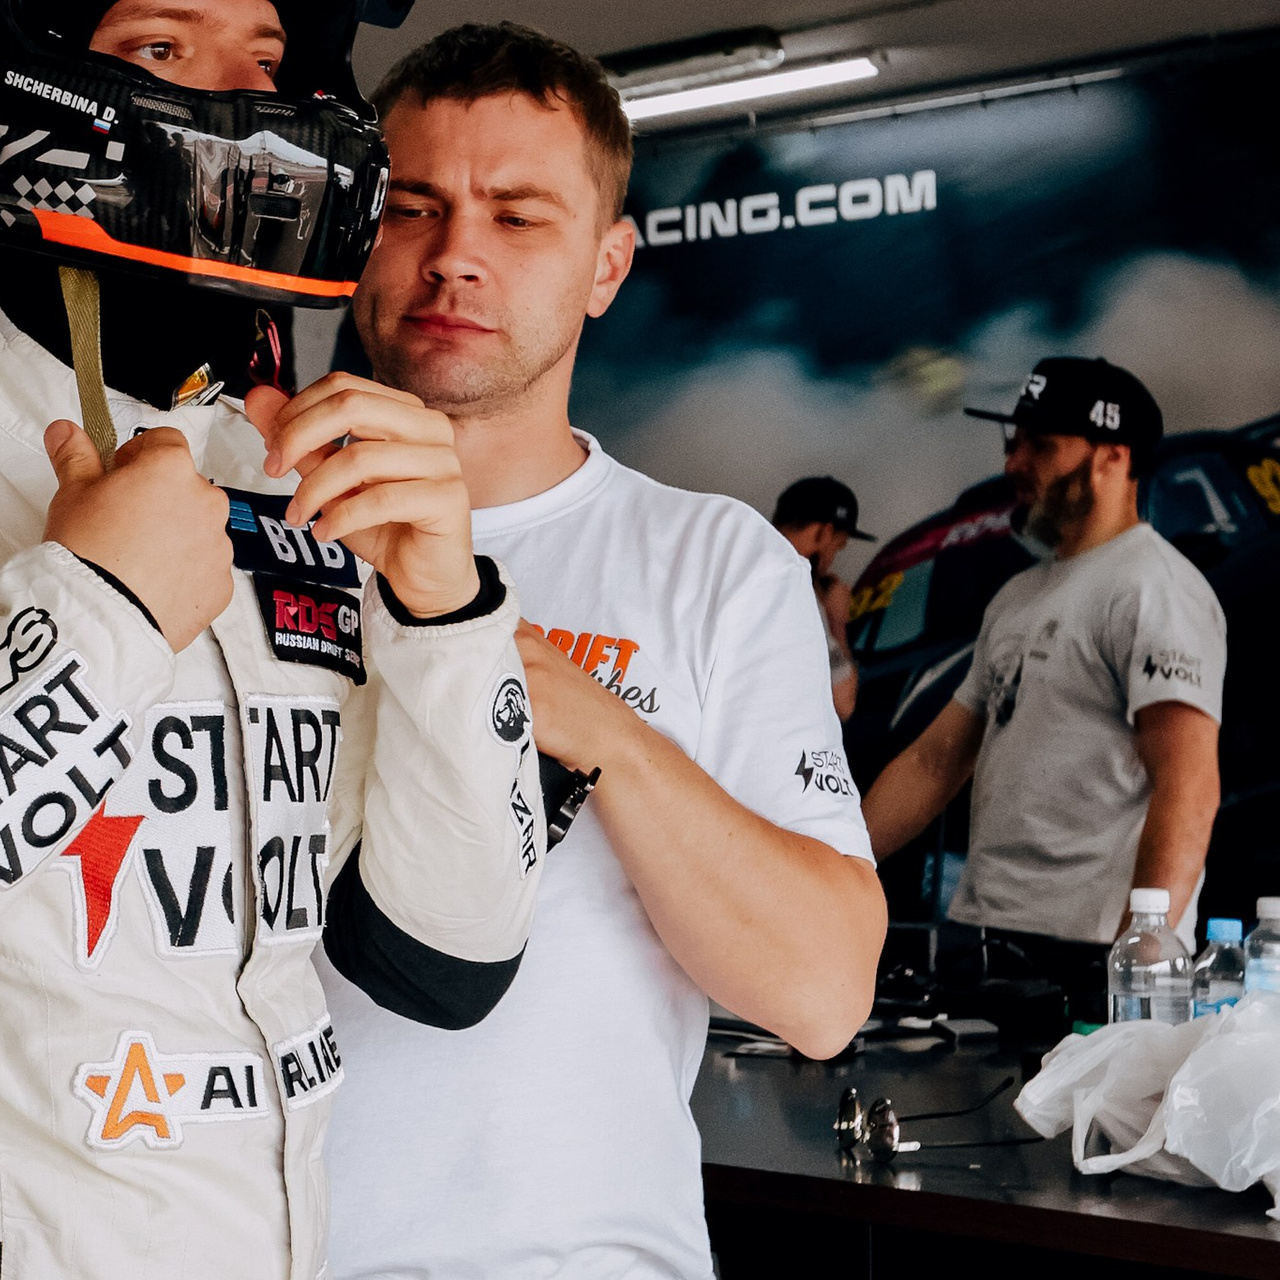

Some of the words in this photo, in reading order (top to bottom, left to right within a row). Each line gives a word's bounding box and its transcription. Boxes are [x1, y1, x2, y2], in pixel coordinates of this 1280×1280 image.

[4, 70, 98, 116] SHCHERBINA
[102, 106, 119, 125] D.
[1090, 400, 1120, 430] 45
[273, 589, 339, 641] RDS
[338, 604, 359, 637] GP
[275, 631, 320, 652] RUSSIAN
[320, 640, 343, 660] DRIFT
[148, 707, 341, 814] START
[143, 834, 328, 948] VOLT
